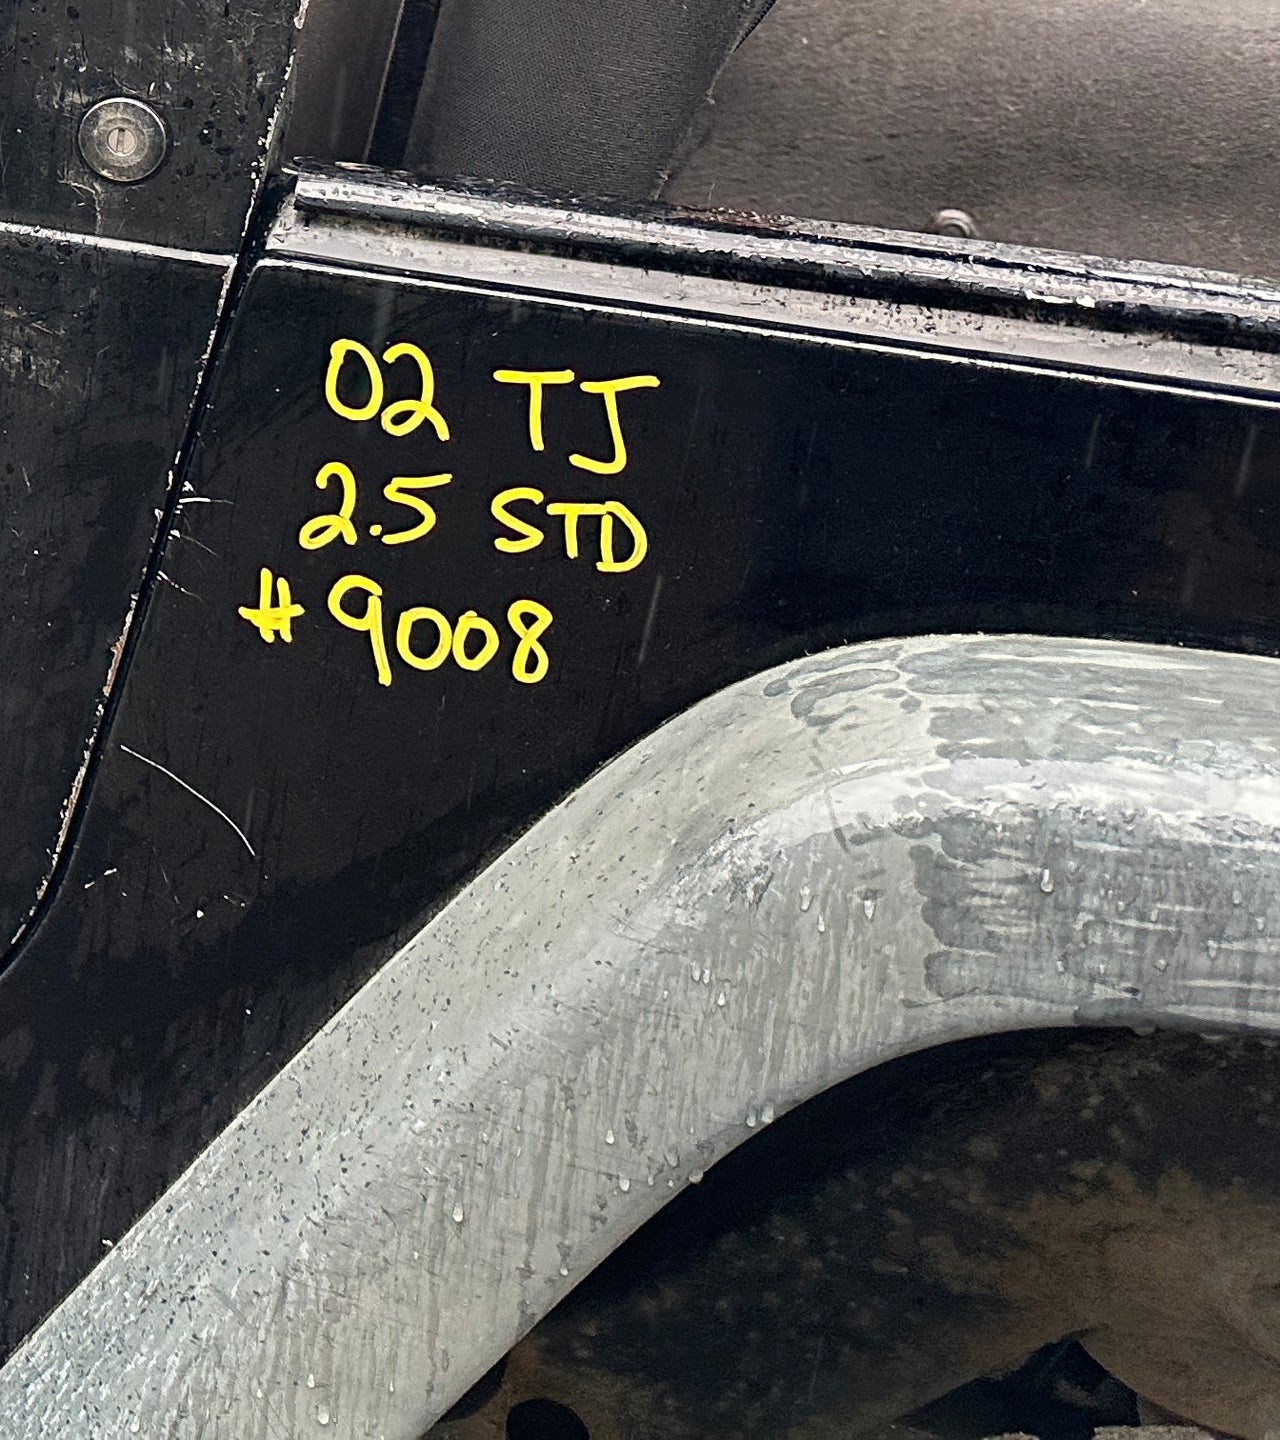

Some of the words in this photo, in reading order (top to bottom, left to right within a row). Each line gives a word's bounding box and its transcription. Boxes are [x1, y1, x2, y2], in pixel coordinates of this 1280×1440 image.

[325, 338, 450, 441] 02
[493, 369, 661, 475] TJ
[298, 461, 453, 551] 2.5
[490, 486, 648, 572] STD
